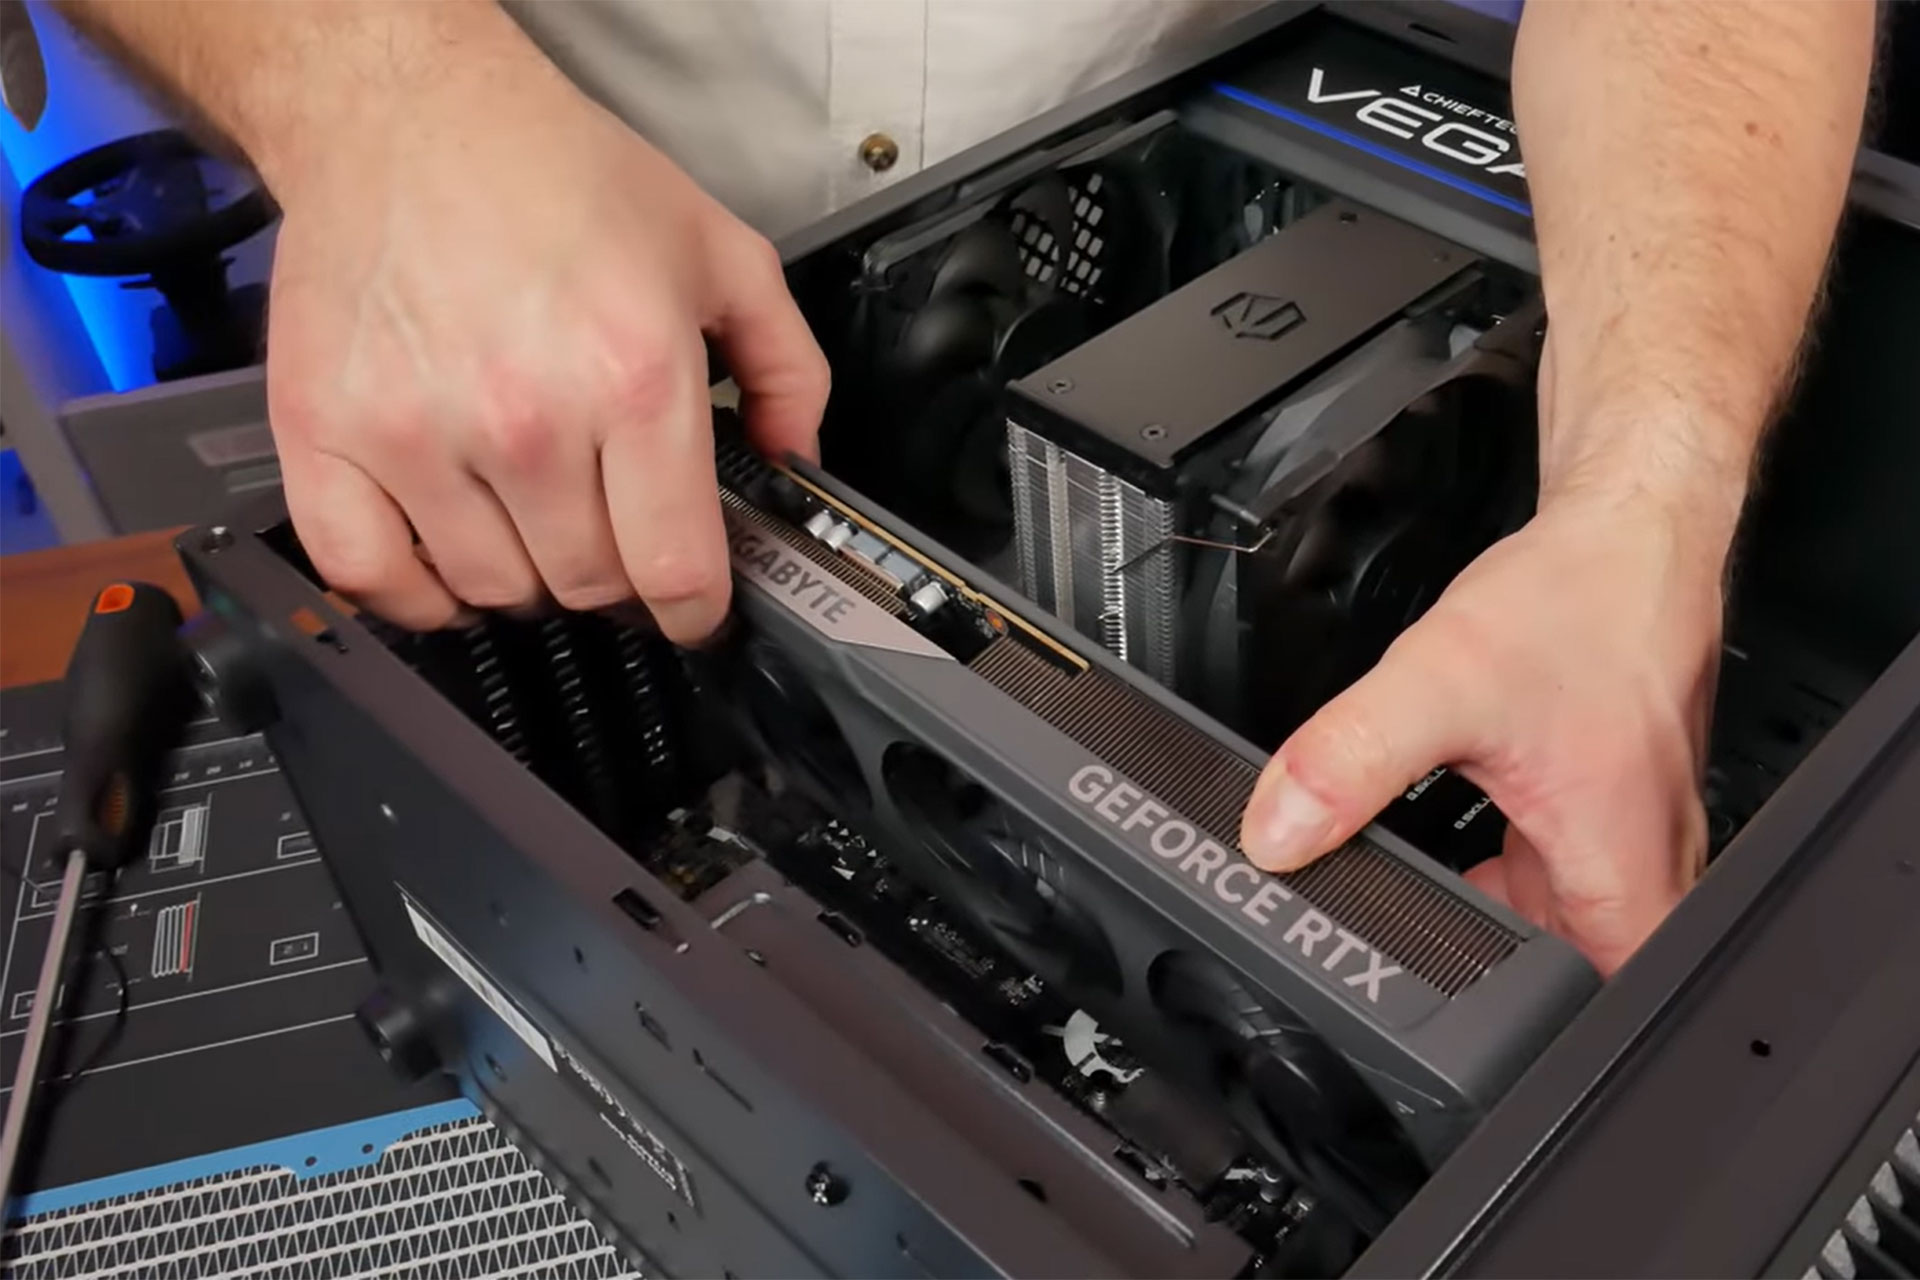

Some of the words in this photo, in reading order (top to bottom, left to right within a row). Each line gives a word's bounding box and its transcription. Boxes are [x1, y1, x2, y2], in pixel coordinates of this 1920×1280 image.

[729, 519, 857, 625] IGABYTE
[1068, 765, 1293, 926] GEFORCE
[1282, 908, 1403, 1003] RTX
